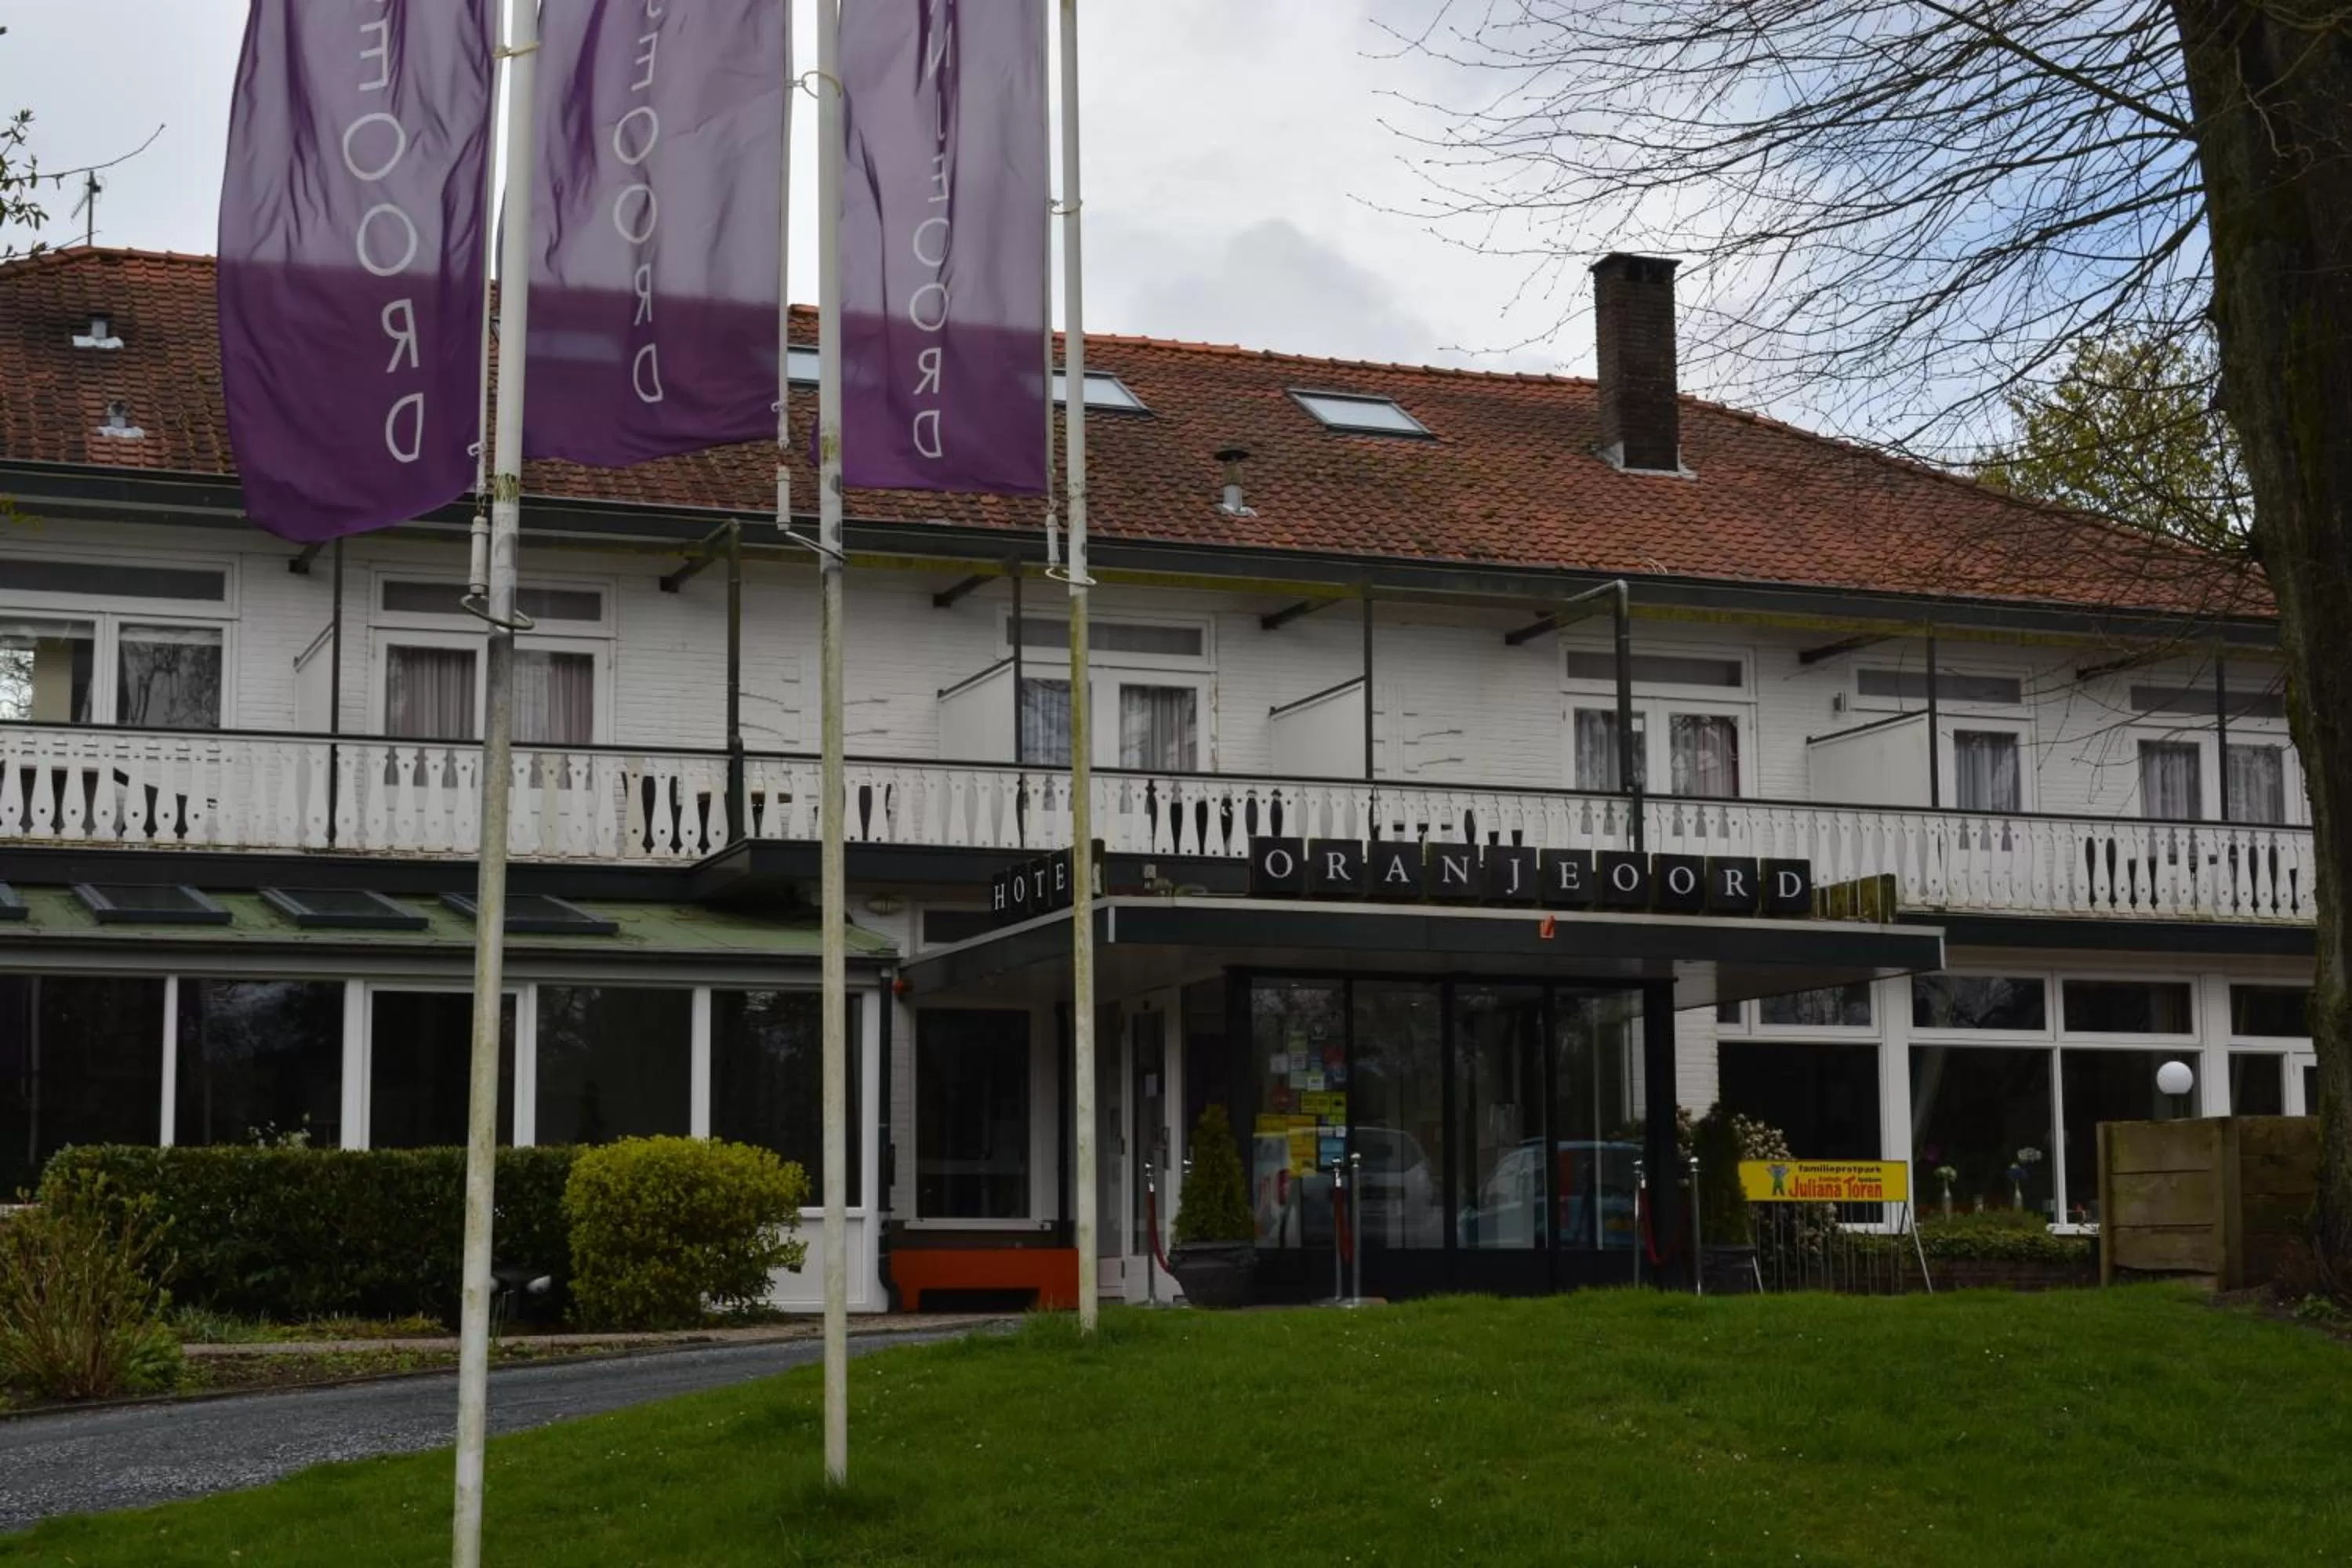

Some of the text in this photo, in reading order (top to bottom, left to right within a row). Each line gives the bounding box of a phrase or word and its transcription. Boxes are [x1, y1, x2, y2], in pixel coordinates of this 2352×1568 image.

[994, 849, 1802, 909] HOTE ORANJEOORD
[1788, 1176, 1842, 1198] Juliana
